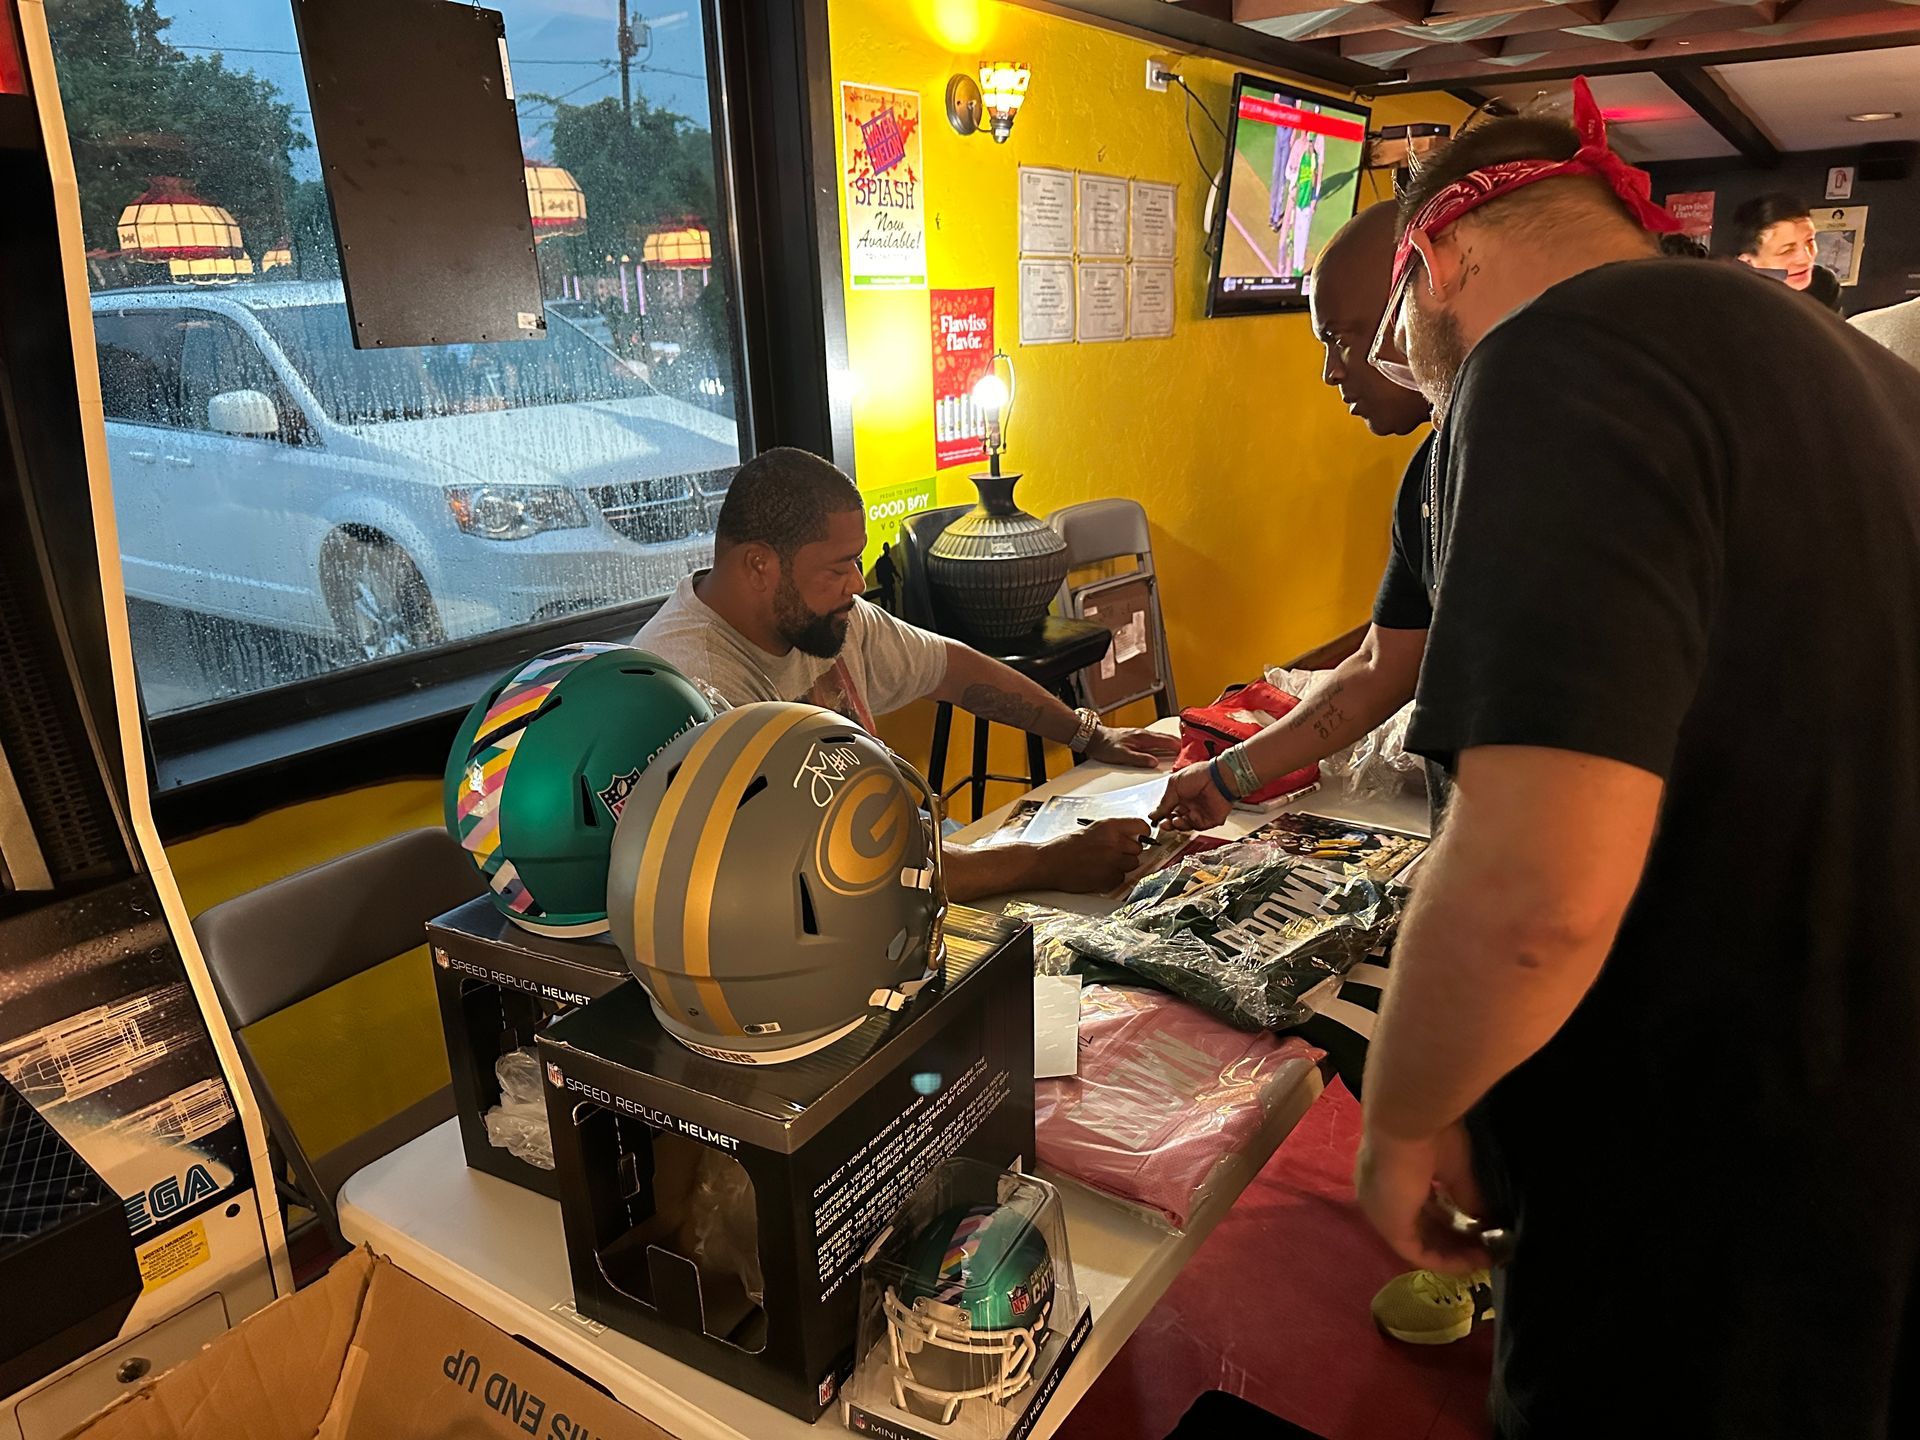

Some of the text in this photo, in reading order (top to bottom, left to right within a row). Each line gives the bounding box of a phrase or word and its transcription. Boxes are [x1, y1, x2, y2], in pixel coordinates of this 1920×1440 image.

[863, 115, 897, 149] WATER
[870, 134, 904, 171] MELON
[855, 177, 914, 209] SPLASH
[857, 229, 922, 249] Available!
[874, 211, 904, 232] Now
[946, 332, 982, 351] flavor.
[868, 492, 929, 520] GOOD BOY
[451, 958, 488, 978] SPEED
[491, 970, 538, 992] REPLICA
[542, 985, 590, 1006] HELMET
[566, 1078, 610, 1104] SPEED
[615, 1096, 673, 1128] REPLICA
[678, 1119, 740, 1150] HELMET
[814, 1056, 985, 1218] SUPPORT YOUR FAVORITE NFL TEAM AND CAPTURE THE
[814, 1166, 845, 1198] COLLECT
[847, 1146, 866, 1168] YOUR
[868, 1116, 900, 1149] FAVORITE
[816, 1182, 860, 1226] EXCITEMENT
[861, 1168, 876, 1186] AND
[877, 1141, 905, 1170] REALISM
[906, 1131, 915, 1144] OF
[916, 1104, 946, 1134] FOOTBALL
[948, 1094, 956, 1105] BY
[956, 1062, 988, 1096] COLLECTING
[123, 1164, 220, 1232] EGA
[818, 1218, 852, 1256] DESIGNED
[854, 1208, 864, 1220] TO
[866, 1178, 894, 1210] REFLECT
[896, 1165, 909, 1180] THE
[910, 1136, 940, 1168] EXTERIOR
[941, 1119, 956, 1138] LOOK
[958, 1110, 966, 1121] OF
[818, 1250, 830, 1264] ON
[854, 1206, 876, 1230] THESE
[878, 1184, 898, 1208] SPEED
[900, 1160, 925, 1186] REPLICA
[926, 1132, 952, 1159] HELMETS
[954, 1120, 965, 1134] ARE
[966, 1107, 976, 1120] THE
[819, 1256, 834, 1274] FOR
[836, 1240, 850, 1257] THE
[852, 1220, 870, 1242] TRUE
[872, 1196, 898, 1224] SPORTS
[898, 1181, 912, 1197] FAN
[914, 1168, 926, 1183] AND
[928, 1150, 943, 1169] LOOK
[944, 1130, 962, 1152] GREAT
[964, 1122, 970, 1133] AT
[853, 1178, 875, 1202] SPEED
[876, 1152, 904, 1180] REPLICA
[820, 1266, 834, 1282] THE
[882, 1206, 896, 1222] ARE
[898, 1188, 914, 1208] ALSO
[946, 1123, 978, 1158] COLLECTING
[820, 1276, 844, 1302] START
[1012, 1296, 1029, 1313] NFL
[1070, 1318, 1090, 1352] Riddell
[443, 1348, 481, 1394] UP
[1030, 1368, 1060, 1420] HELMET
[484, 1372, 546, 1436] END
[871, 1424, 896, 1440] MINI
